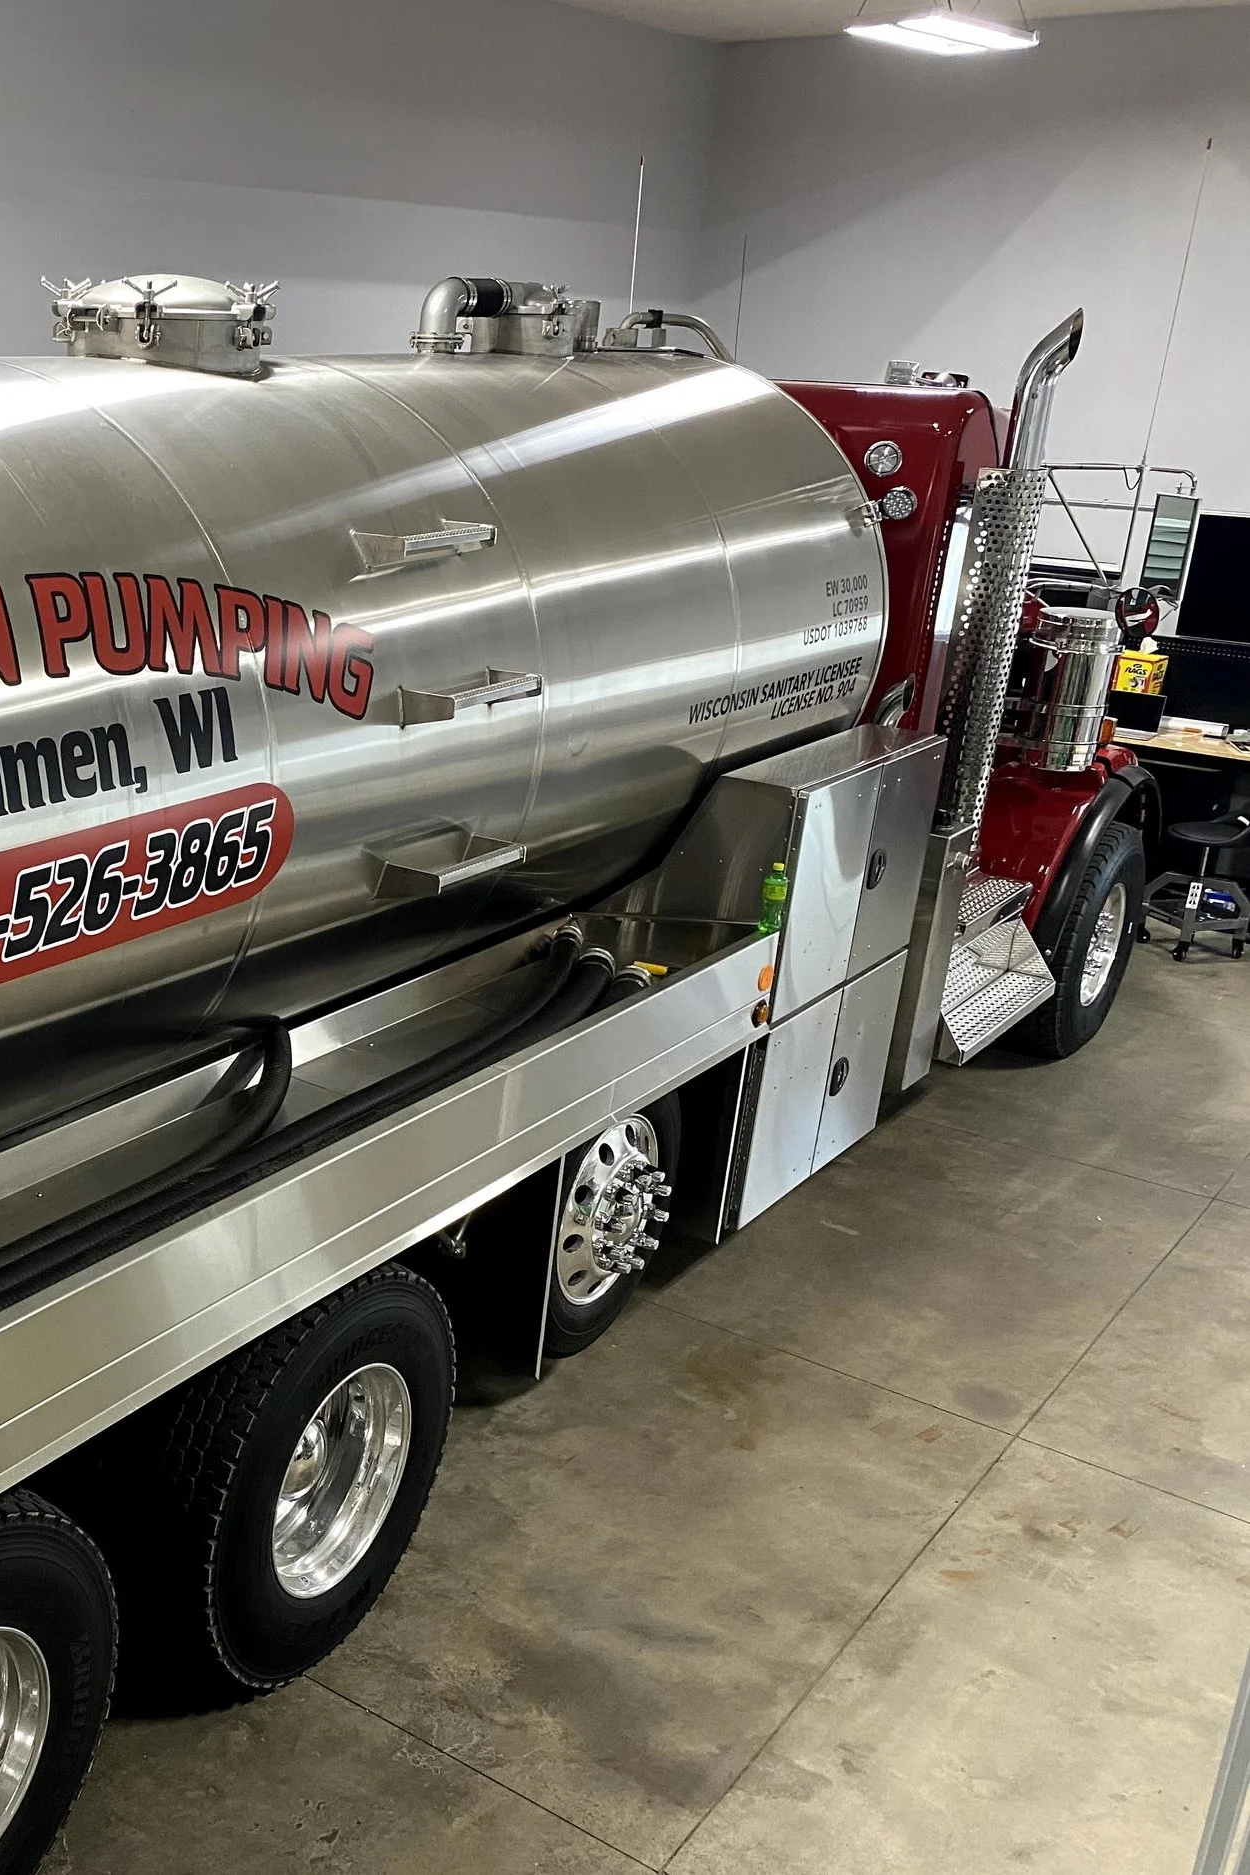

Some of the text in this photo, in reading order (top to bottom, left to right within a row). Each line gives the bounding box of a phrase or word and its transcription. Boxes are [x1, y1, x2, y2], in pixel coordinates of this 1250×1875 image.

[825, 574, 868, 597] EW 30,000
[832, 595, 869, 618] LC 70959
[25, 572, 375, 720] PUMPING
[803, 615, 868, 646] USDOT 1039768
[1125, 667, 1148, 675] RAGS
[689, 656, 862, 724] WISCONSIN SANITARY LICENSEE
[770, 677, 857, 720] LICENSE NO. 904
[154, 687, 238, 774] WI
